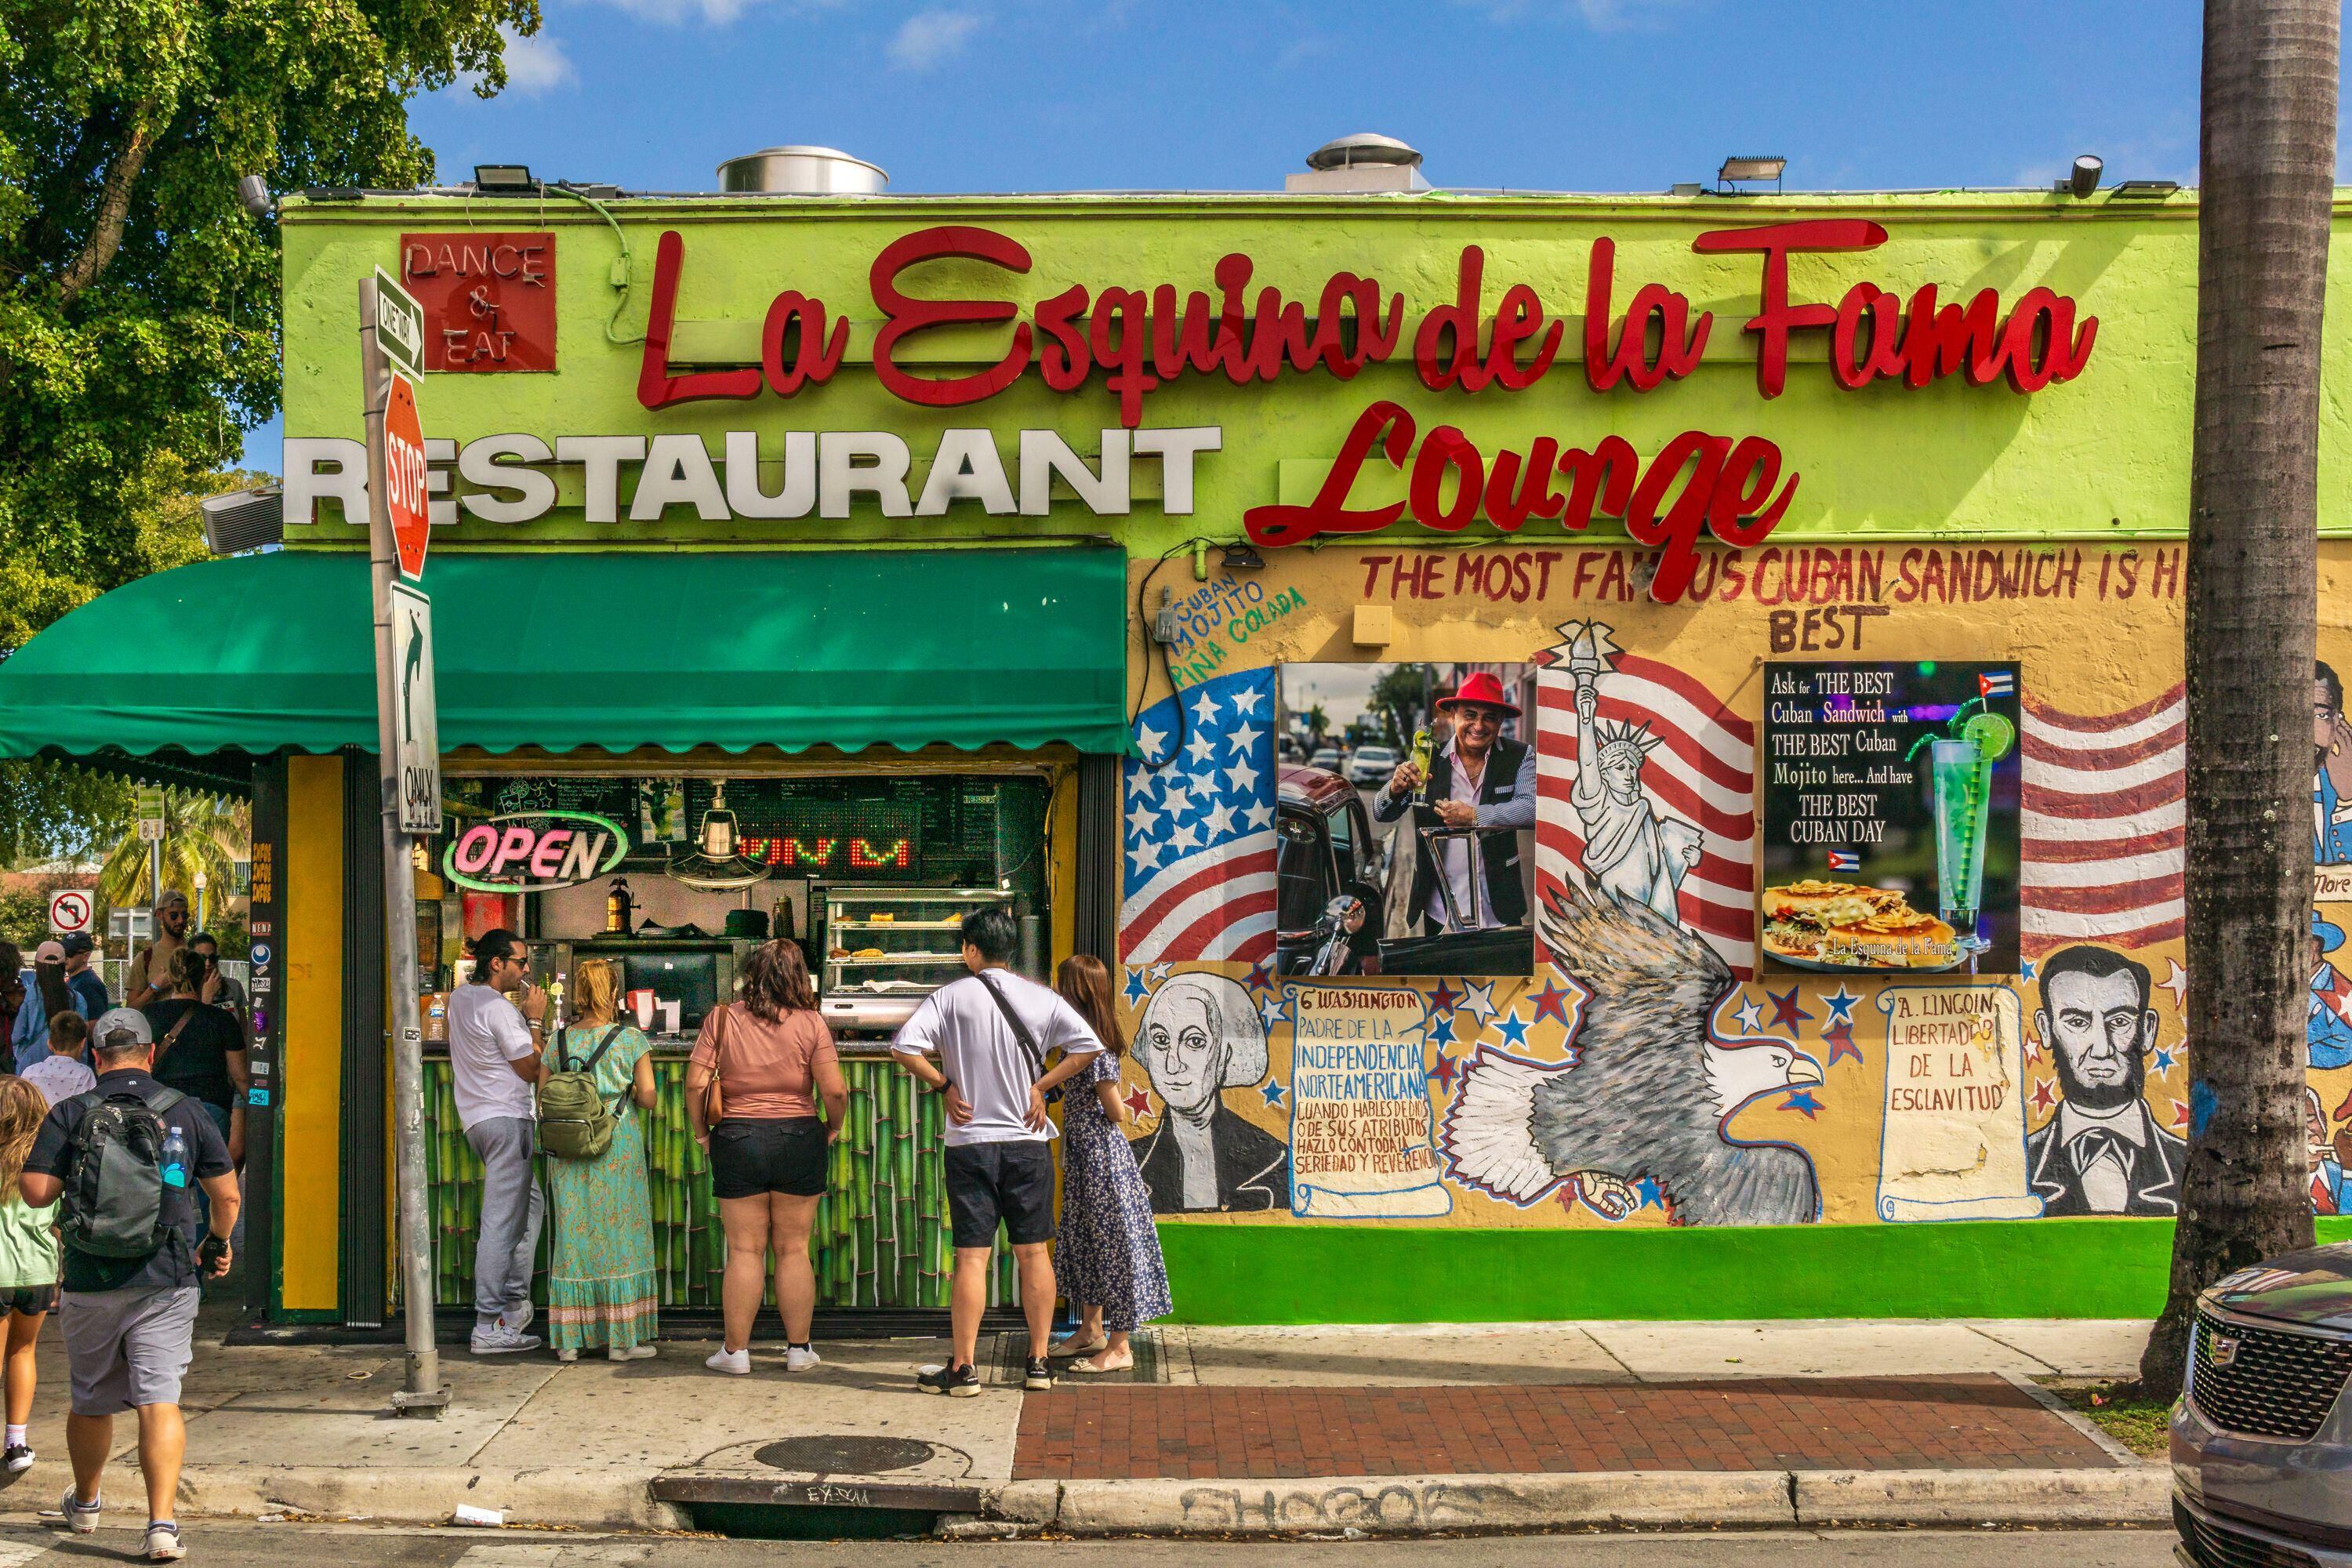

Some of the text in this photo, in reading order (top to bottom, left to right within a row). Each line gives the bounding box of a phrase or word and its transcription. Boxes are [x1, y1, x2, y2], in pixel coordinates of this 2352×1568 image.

[405, 243, 545, 287] DANCE
[470, 285, 499, 320] &
[383, 298, 410, 346] ONE WAY
[637, 220, 2099, 428] La Esquina de la Fama
[442, 329, 516, 364] EAT
[389, 431, 424, 517] STOP
[1243, 401, 1801, 604] Lounge
[1360, 547, 2187, 605] THE MOST FAUS CUBAN SANDWICH IS H
[1168, 581, 1264, 656] MOJITO
[1769, 605, 1890, 653] BEST
[1171, 586, 1307, 688] PIÑA COLADA
[1770, 672, 1893, 695] Ask for THE BEST
[1772, 700, 1908, 724] Cuban Sandwich with
[1772, 729, 1897, 756] THE BEST Cuban
[405, 764, 434, 808] ONLY
[1773, 762, 1827, 789] Mojito
[1866, 766, 1887, 784] And
[1889, 766, 1912, 784] have
[1799, 794, 1878, 816] THE BEST
[1791, 820, 1886, 843] CUBAN DAY
[455, 825, 608, 880] OPEN
[1832, 938, 1953, 961] La Esquina de la Fama
[1898, 996, 1919, 1018] A.
[1299, 1017, 1393, 1040] PADRE DE LA
[1296, 1044, 1422, 1070] INDEPENDENCIA
[1910, 1052, 1973, 1078] DE LA
[1298, 1070, 1428, 1100] NORTEAMERICANA
[1891, 1084, 2002, 1112] ESCLAVITUD
[1297, 1102, 1348, 1120] CUANDO
[1353, 1101, 1392, 1118] HABLES
[1308, 1121, 1323, 1137] DE
[1327, 1120, 1356, 1138] SUS
[1362, 1117, 1428, 1137] ATRIBUTOS
[1297, 1138, 1336, 1154] HAZLO
[1339, 1137, 1367, 1153] CON
[1367, 1137, 1398, 1153] TODA
[1295, 1148, 1439, 1174] SERIEDAD Y REVERENCIA
